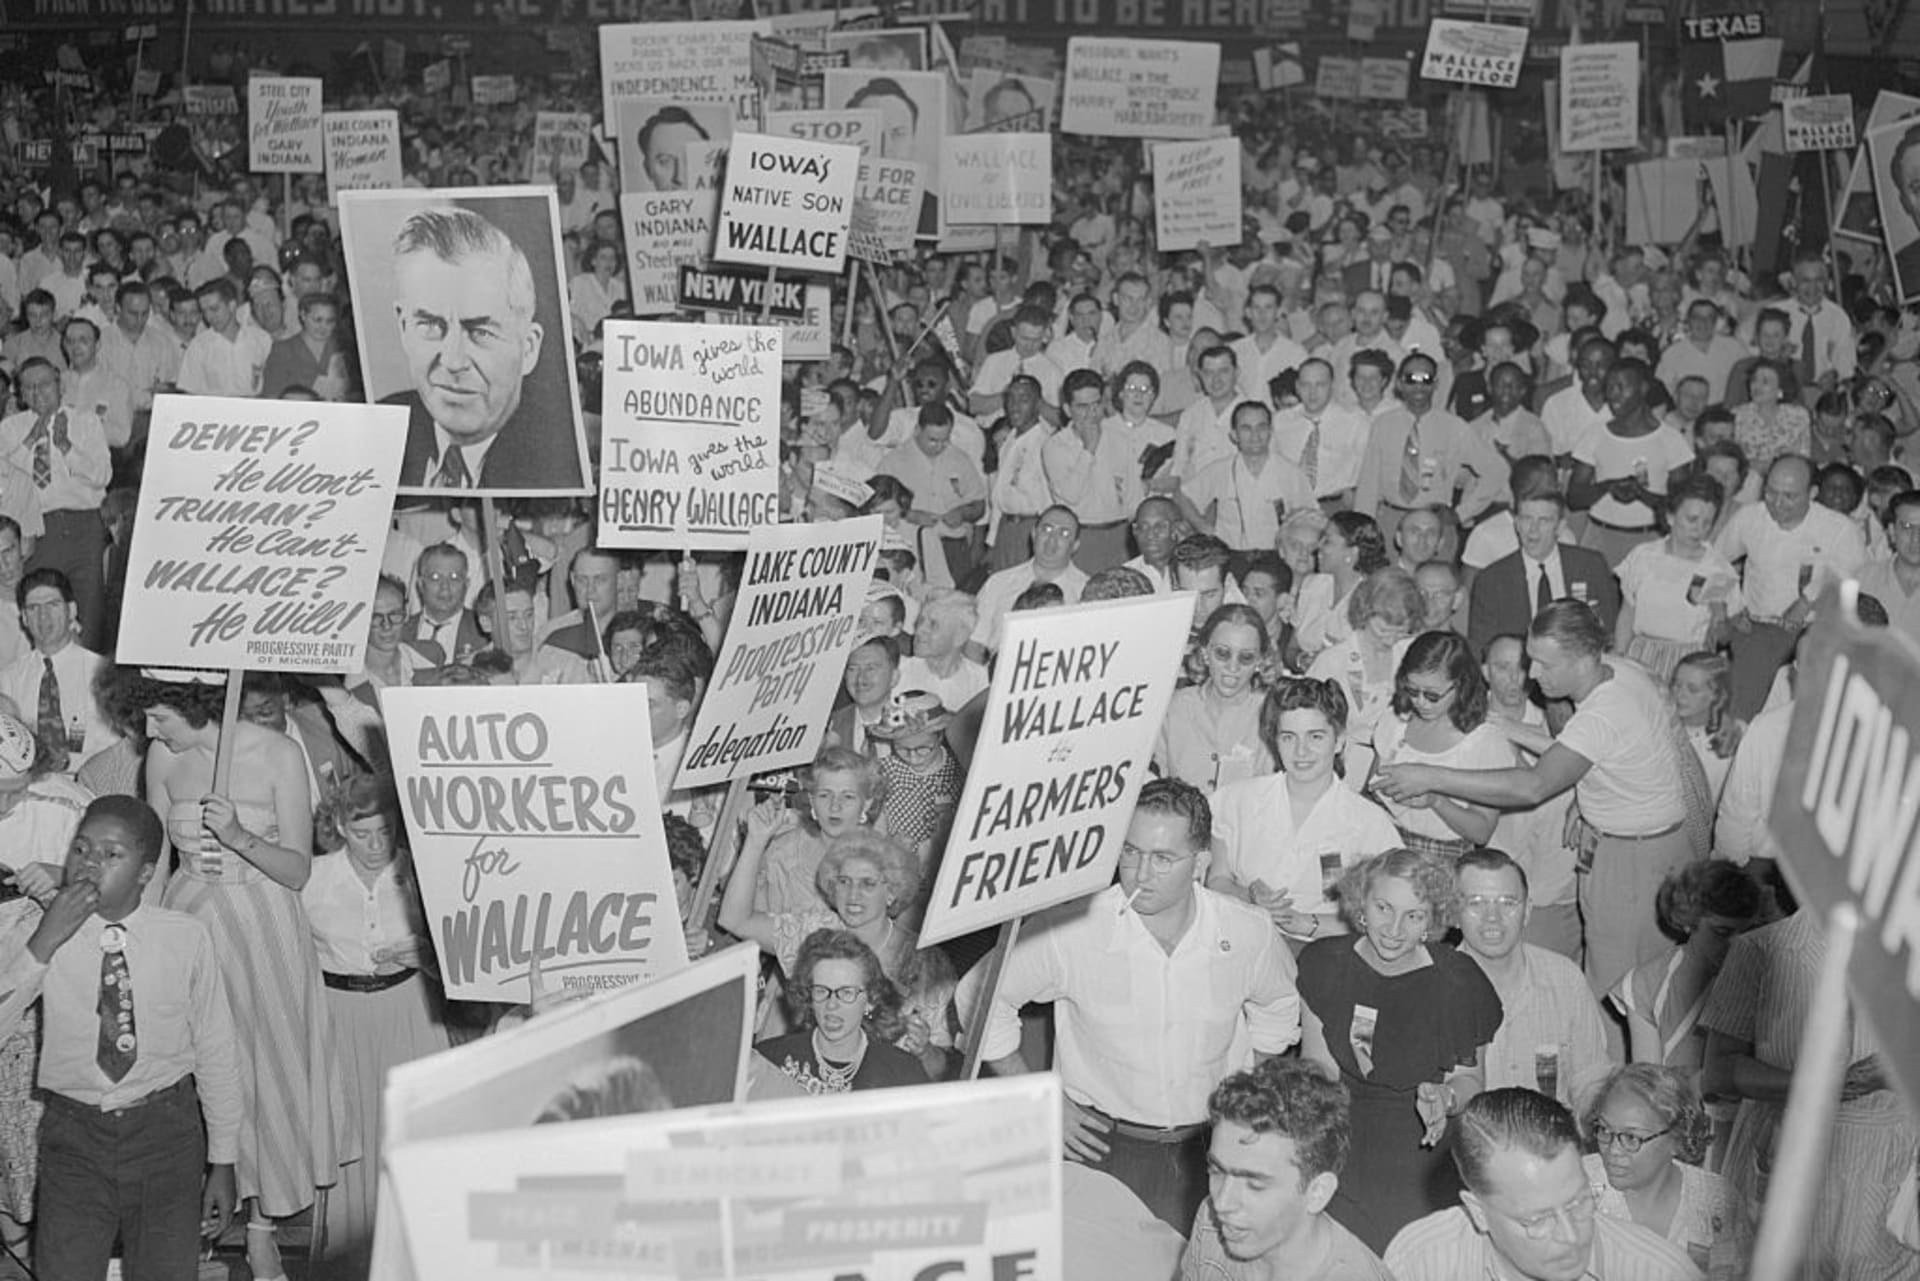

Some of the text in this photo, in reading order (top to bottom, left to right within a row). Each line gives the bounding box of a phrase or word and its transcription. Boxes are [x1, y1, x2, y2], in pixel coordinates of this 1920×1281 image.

[1685, 13, 1762, 39] TEXAS
[1429, 52, 1516, 73] WALLACE
[1446, 66, 1514, 84] TAYLOR
[259, 84, 311, 98] STEEL CITY
[331, 133, 391, 148] INDIANA
[789, 121, 862, 140] STOP
[1787, 123, 1852, 138] WALLACE
[1801, 135, 1853, 148] TAYLOR
[256, 152, 313, 166] INDIANA
[954, 149, 1038, 169] WALLACE
[879, 167, 916, 187] FOR
[645, 198, 694, 217] GARY
[732, 184, 844, 214] NATIVE SON
[862, 183, 912, 206] LACE
[634, 217, 710, 237] INDIANA
[684, 270, 737, 303] NEW
[616, 329, 778, 376] IOWA gives the
[711, 354, 765, 385] world
[623, 389, 762, 424] ABUNDANCE
[168, 419, 320, 457] DEWEY?
[607, 434, 768, 476] IOWA gives the
[710, 451, 770, 481] world
[213, 457, 266, 493] He
[154, 496, 337, 530] TRUMAN?
[602, 487, 682, 525] HENRY
[685, 485, 778, 528] WALLACE
[205, 523, 256, 554] He
[143, 559, 347, 600] WALLACE?
[747, 540, 878, 587] LAKE COUNTY
[747, 583, 843, 628] INDIANA
[188, 599, 366, 648] He Will!
[246, 640, 357, 658] PROGRESSIVE PARTY
[257, 655, 339, 666] OF MICHIGAN
[1009, 637, 1121, 695] HENRY
[1001, 683, 1150, 745] WALLACE
[417, 712, 549, 762] AUTO
[685, 712, 808, 779] delegation
[406, 774, 637, 833] WORKERS
[968, 759, 1133, 842] FARMERS
[462, 834, 521, 903] for
[950, 823, 1106, 910] FRIEND
[441, 890, 658, 987] WALLACE
[805, 1212, 963, 1244] PROSPERITY
